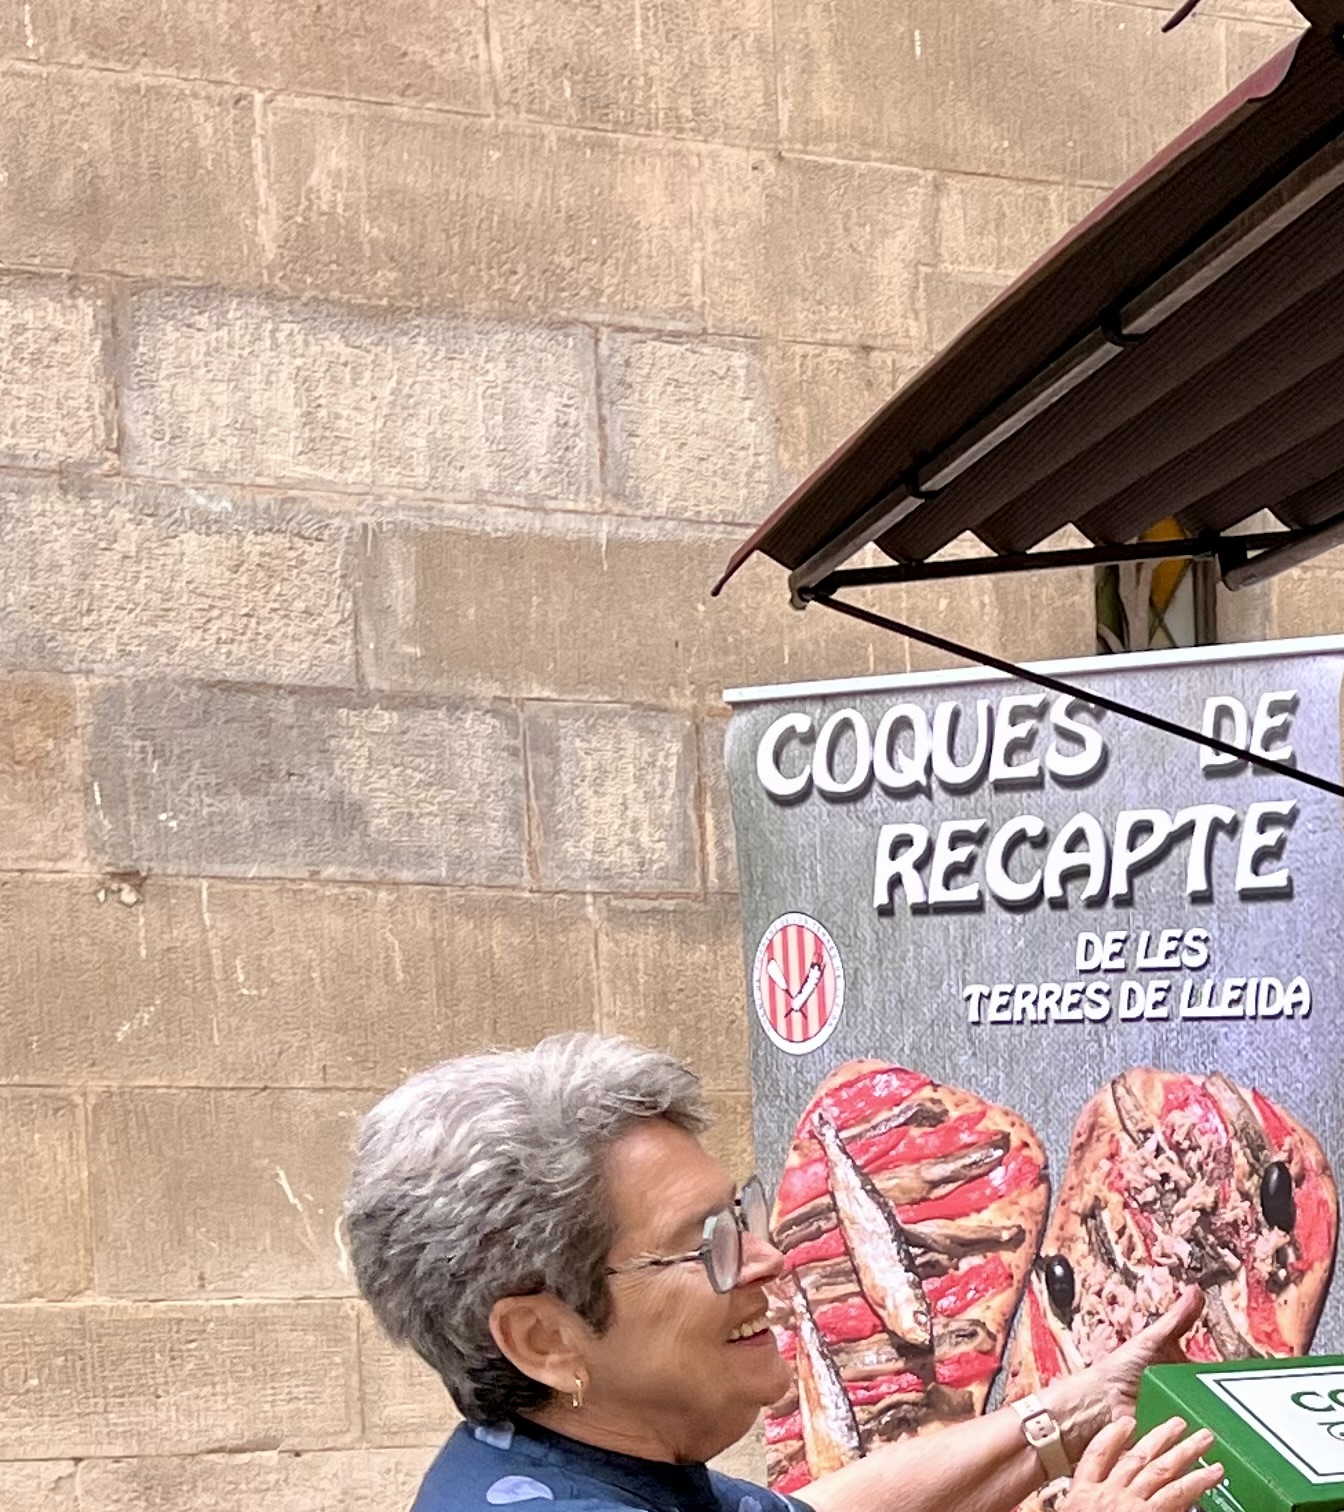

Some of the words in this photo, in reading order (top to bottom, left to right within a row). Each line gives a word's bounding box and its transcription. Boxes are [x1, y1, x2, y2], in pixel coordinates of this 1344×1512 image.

[756, 690, 1106, 798] COQUES
[1200, 689, 1299, 773] DE
[873, 799, 1298, 912] RECAPTE
[1075, 930, 1126, 970] DE
[1135, 927, 1211, 969] LES
[962, 981, 1110, 1023] TERRES
[1118, 981, 1174, 1021] DE
[1179, 976, 1311, 1020] LLEIDA
